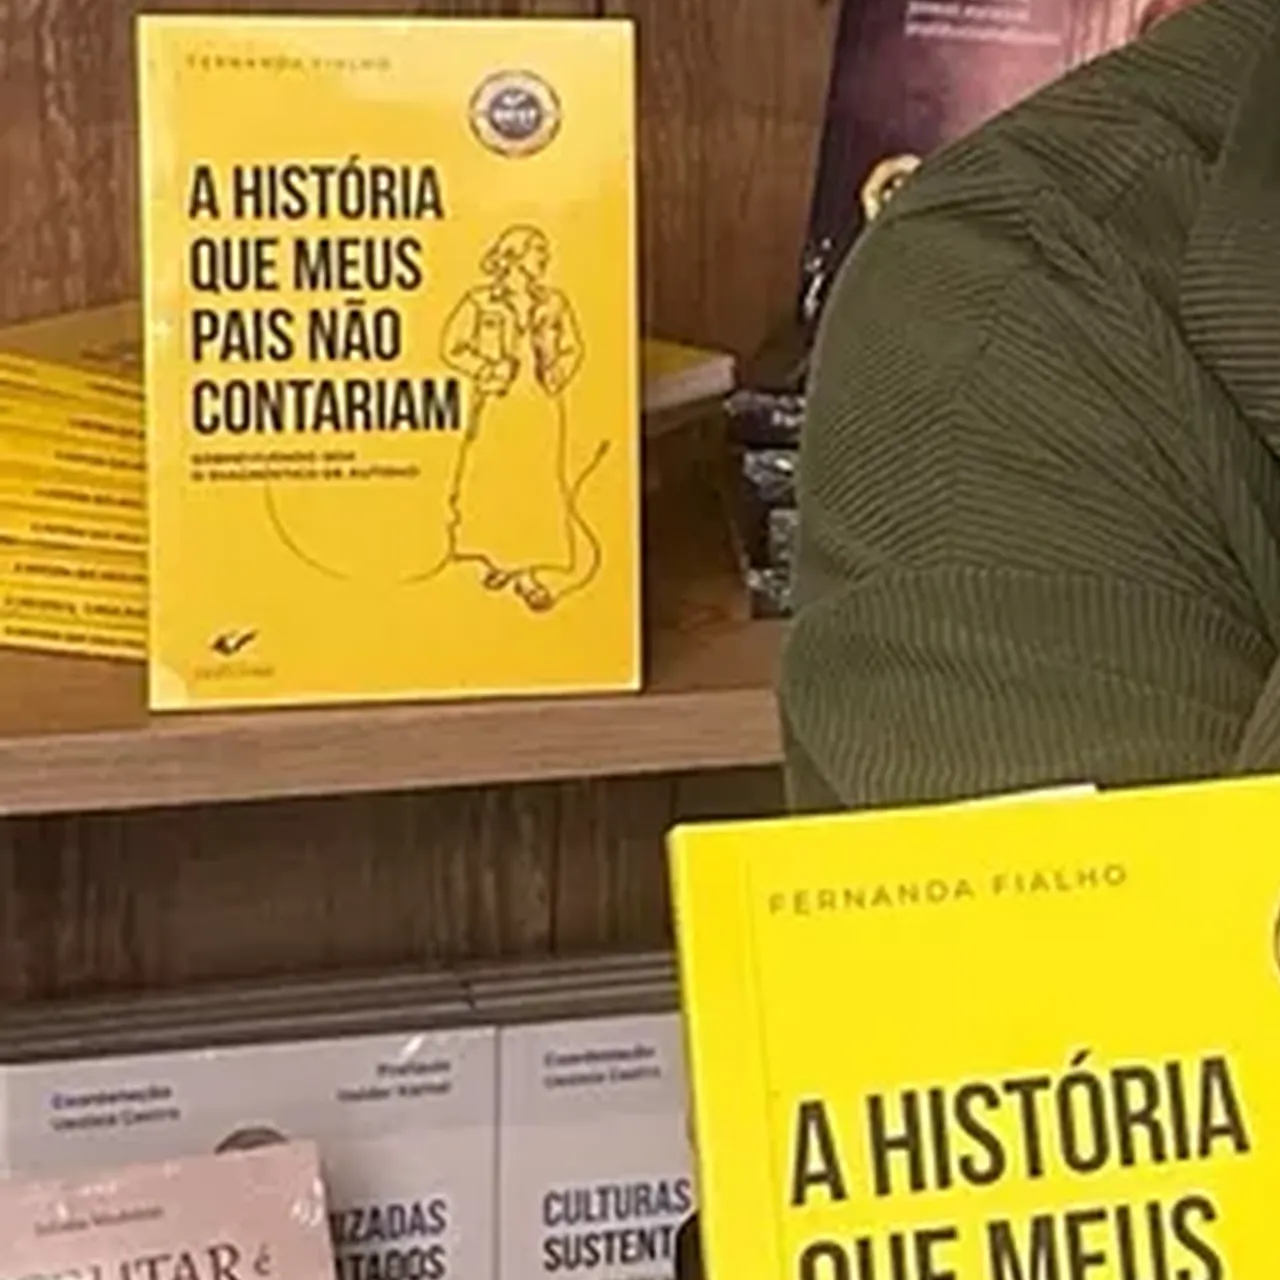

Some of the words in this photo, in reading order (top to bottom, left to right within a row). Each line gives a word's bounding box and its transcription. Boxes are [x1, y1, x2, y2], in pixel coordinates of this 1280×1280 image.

[189, 165, 221, 221] A
[235, 155, 444, 221] HISTÓRIA
[190, 236, 278, 296] QUE
[294, 236, 423, 291] MEUS
[191, 307, 293, 363] PAIS
[310, 299, 402, 361] NÃO
[192, 378, 462, 435] CONTARIAM
[768, 880, 976, 918] FERNANDA
[993, 862, 1130, 898] FIALHO
[790, 1098, 848, 1207] A
[869, 1049, 1251, 1198] HISTÓRIA
[543, 1178, 692, 1228] CULTURAS
[542, 1224, 674, 1273] SUSTENT
